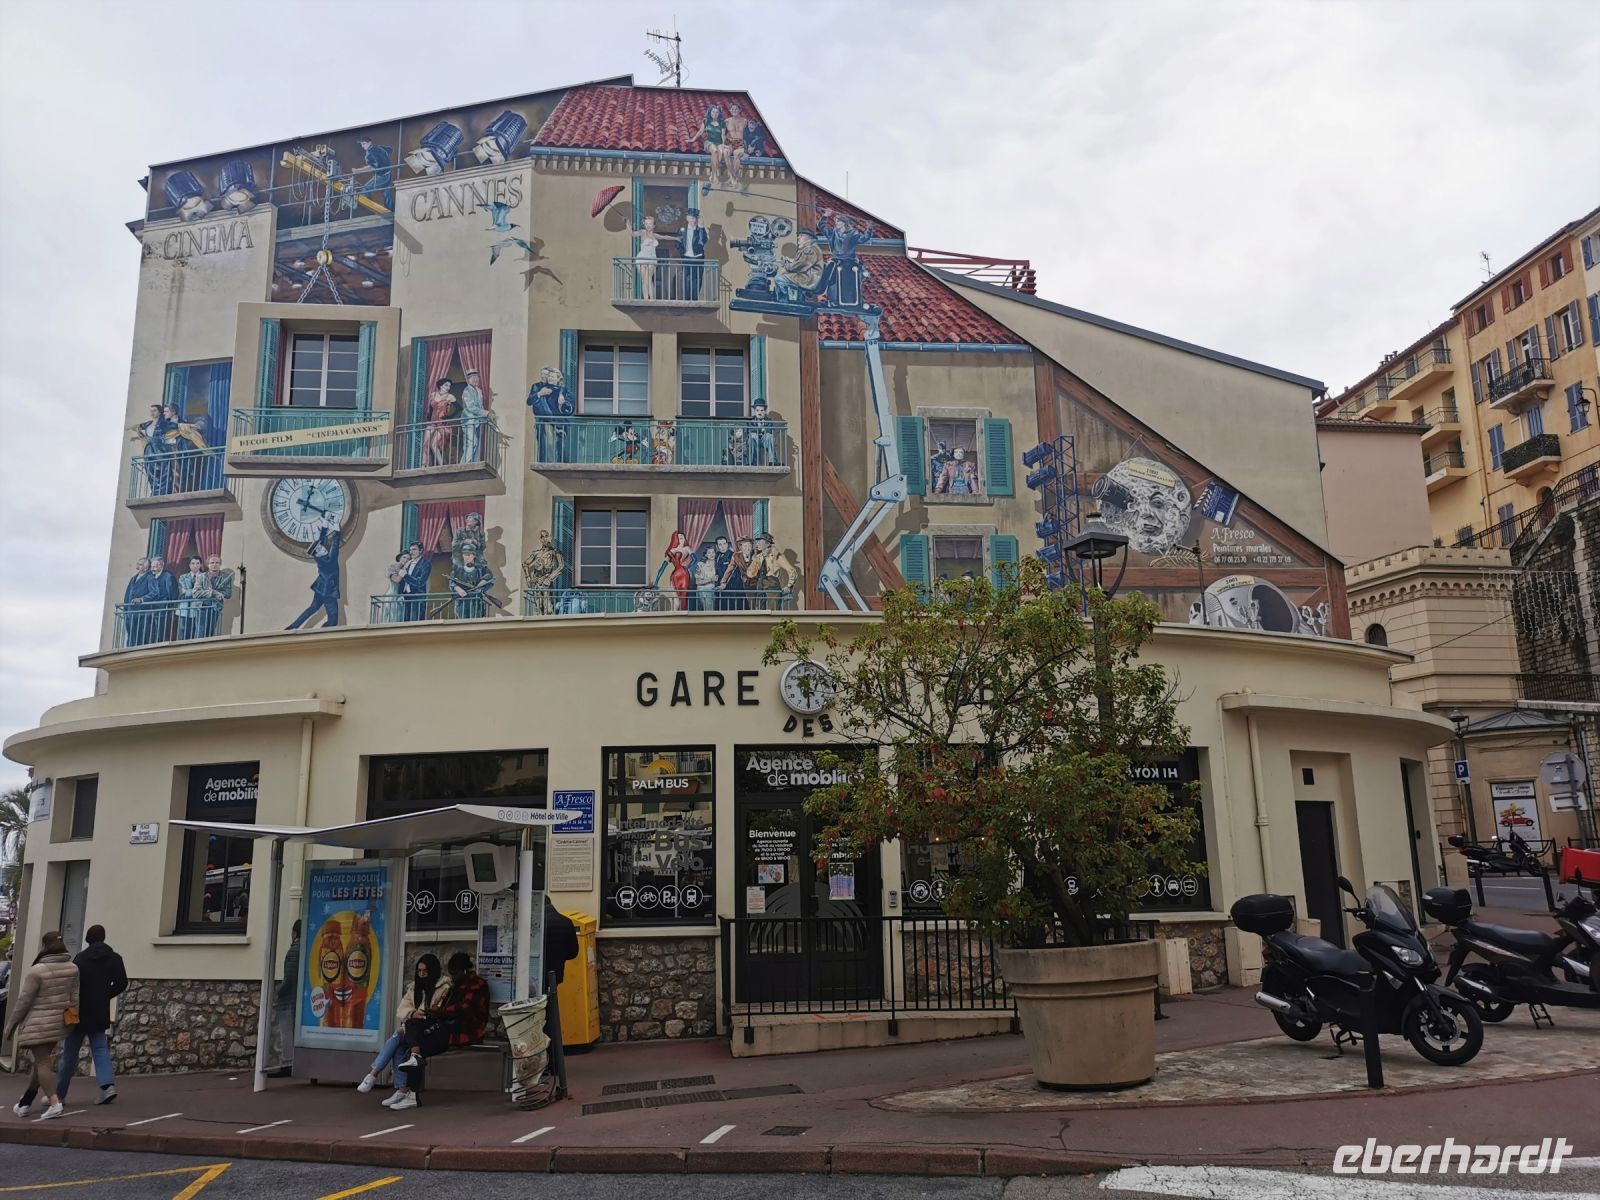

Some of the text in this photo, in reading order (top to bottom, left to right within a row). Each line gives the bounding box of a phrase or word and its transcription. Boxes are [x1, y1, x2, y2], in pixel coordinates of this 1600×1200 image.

[411, 174, 523, 223] CANNES
[163, 218, 254, 260] CINEMA
[271, 433, 293, 444] FILM
[1210, 527, 1255, 543] A.Fresco
[1212, 543, 1272, 554] Peintures murales
[636, 670, 760, 707] GARE
[782, 713, 834, 738] DES
[745, 756, 813, 773] Agence
[1457, 764, 1465, 776] P
[767, 767, 789, 786] de
[205, 777, 248, 791] Agence
[632, 778, 689, 790] PALM BUS
[203, 790, 218, 802] de
[555, 794, 592, 807] A.Fresco
[530, 812, 547, 820] Hôtel
[547, 812, 555, 820] de
[555, 812, 569, 820] Ville
[615, 830, 705, 852] Parking Bus
[749, 829, 797, 839] Bienvenue
[313, 873, 380, 883] PARTAGEZ DU SOLEIL
[312, 883, 385, 899] POUR LES FÊTES
